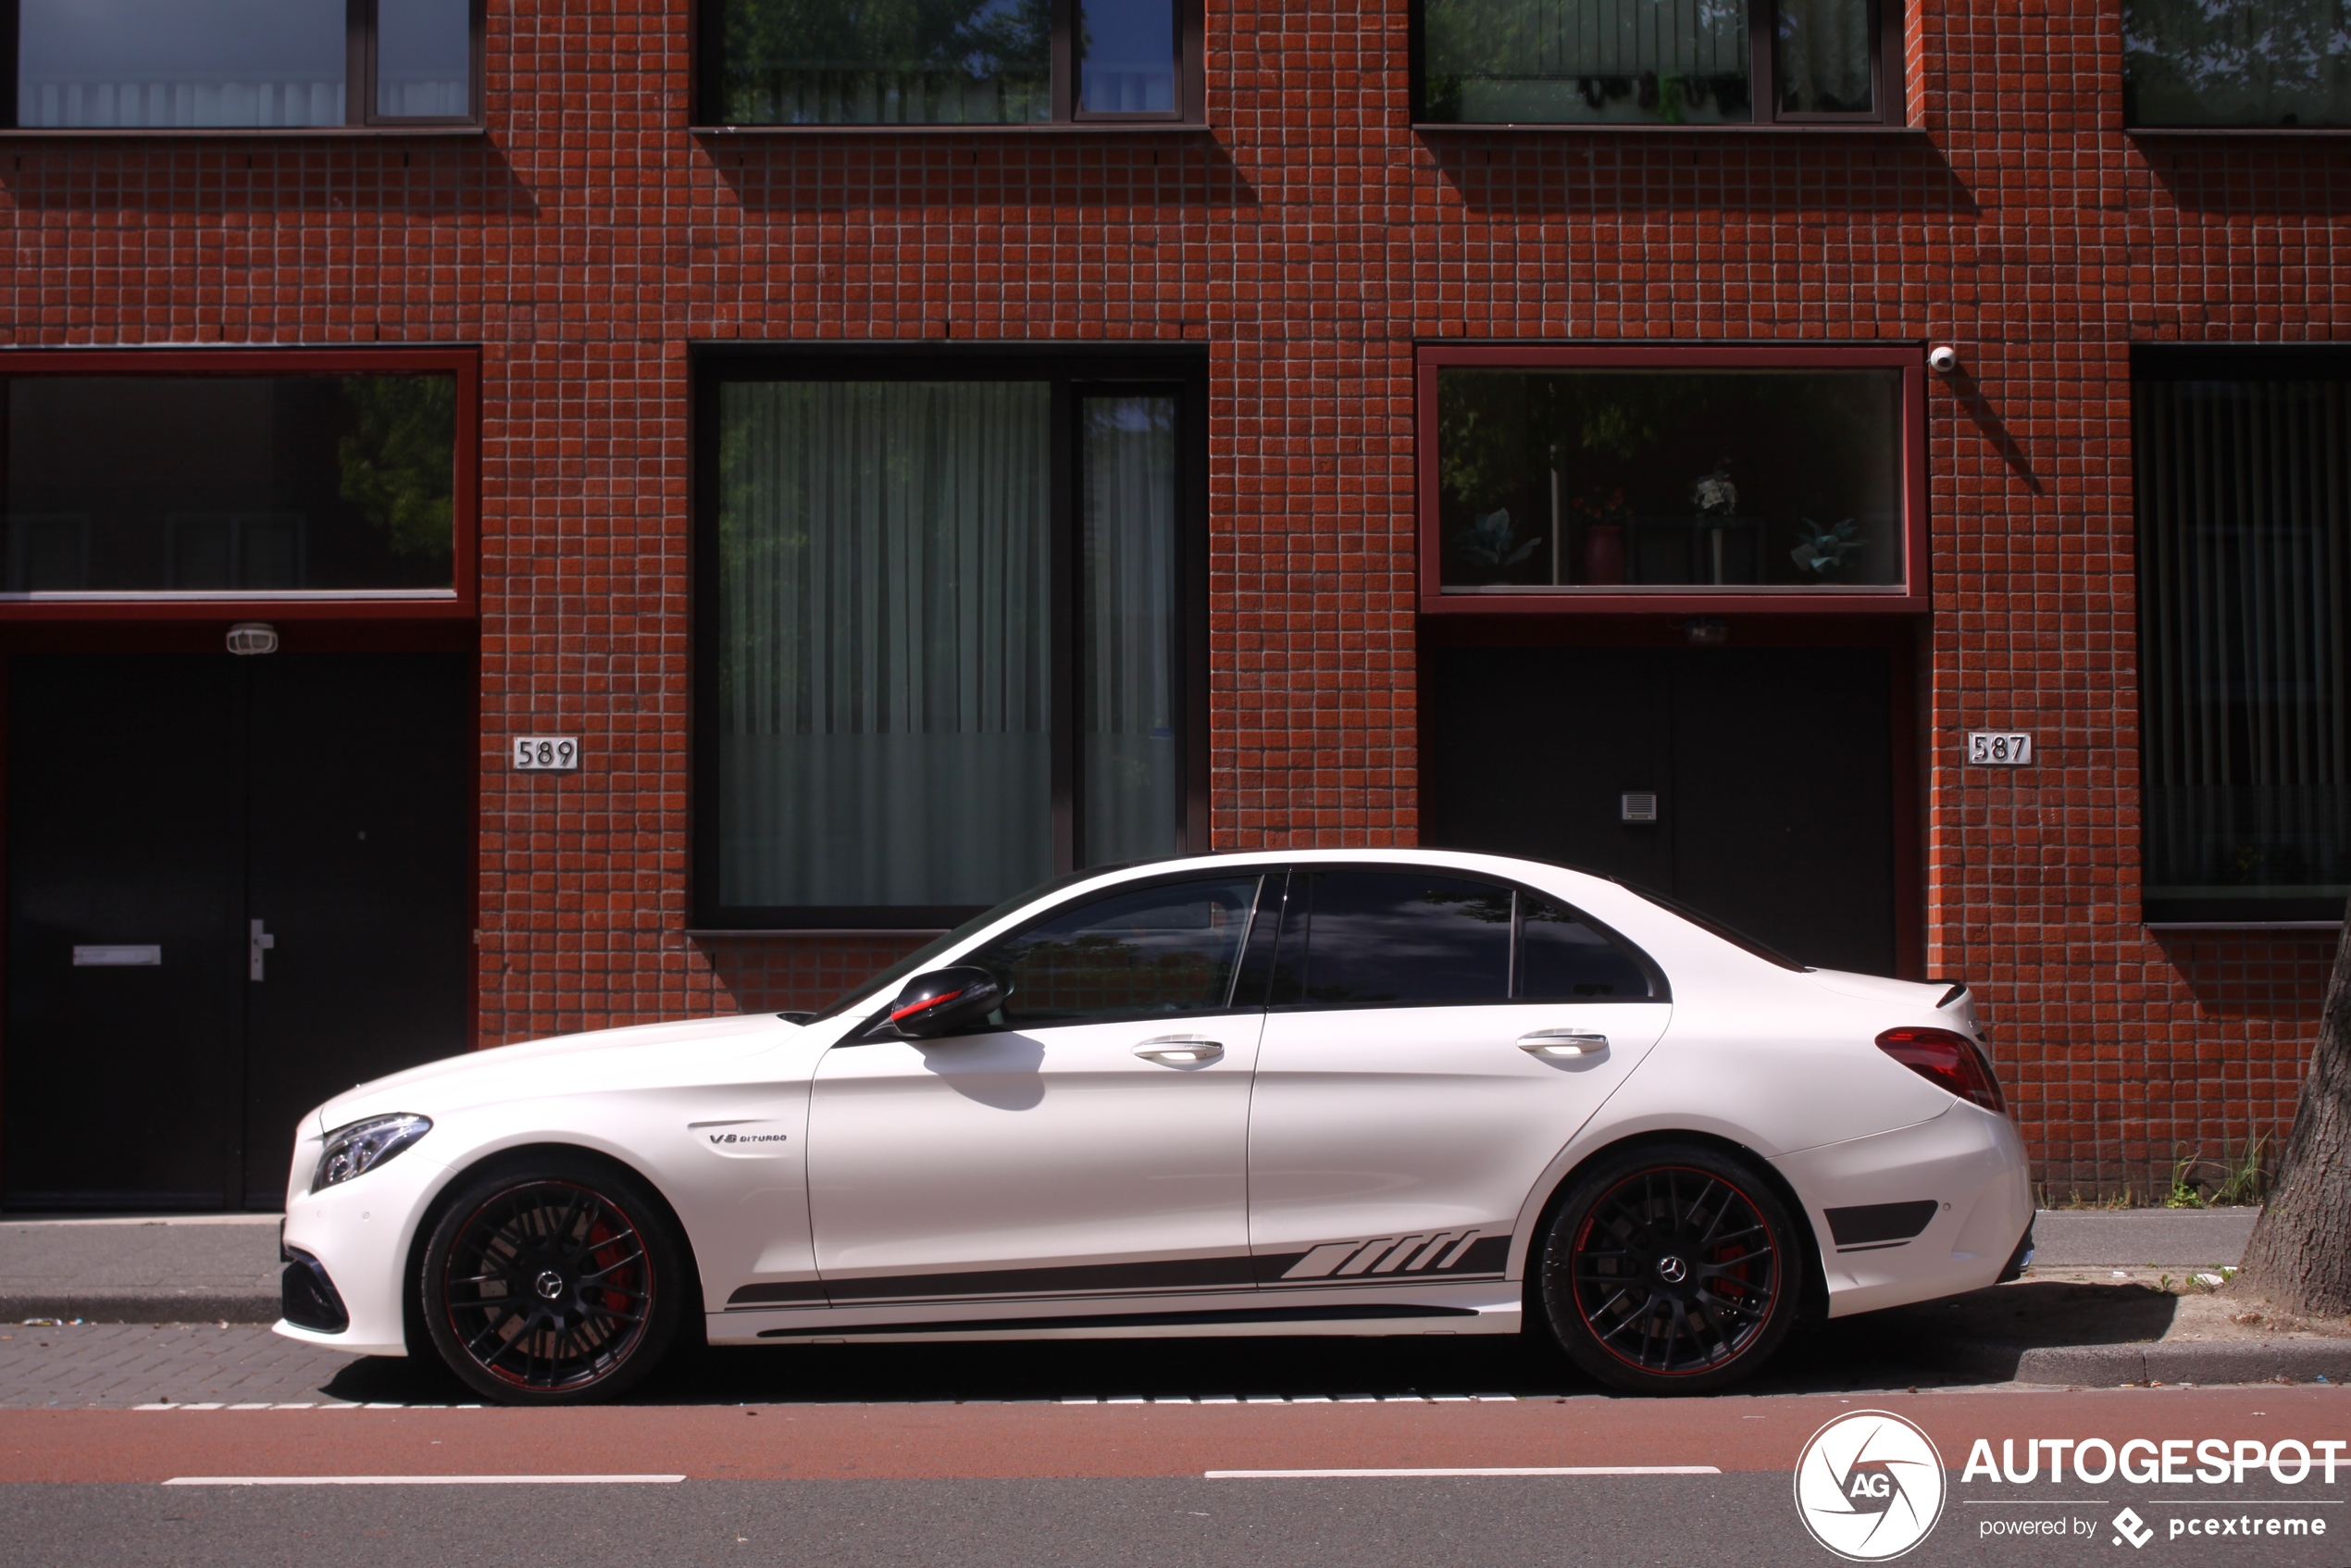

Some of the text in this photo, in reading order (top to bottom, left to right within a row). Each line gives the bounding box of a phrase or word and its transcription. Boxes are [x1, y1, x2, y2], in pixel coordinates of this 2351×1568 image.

[518, 740, 573, 765] 589
[1972, 735, 2025, 762] 587
[709, 1134, 788, 1144] V8 BITURBO
